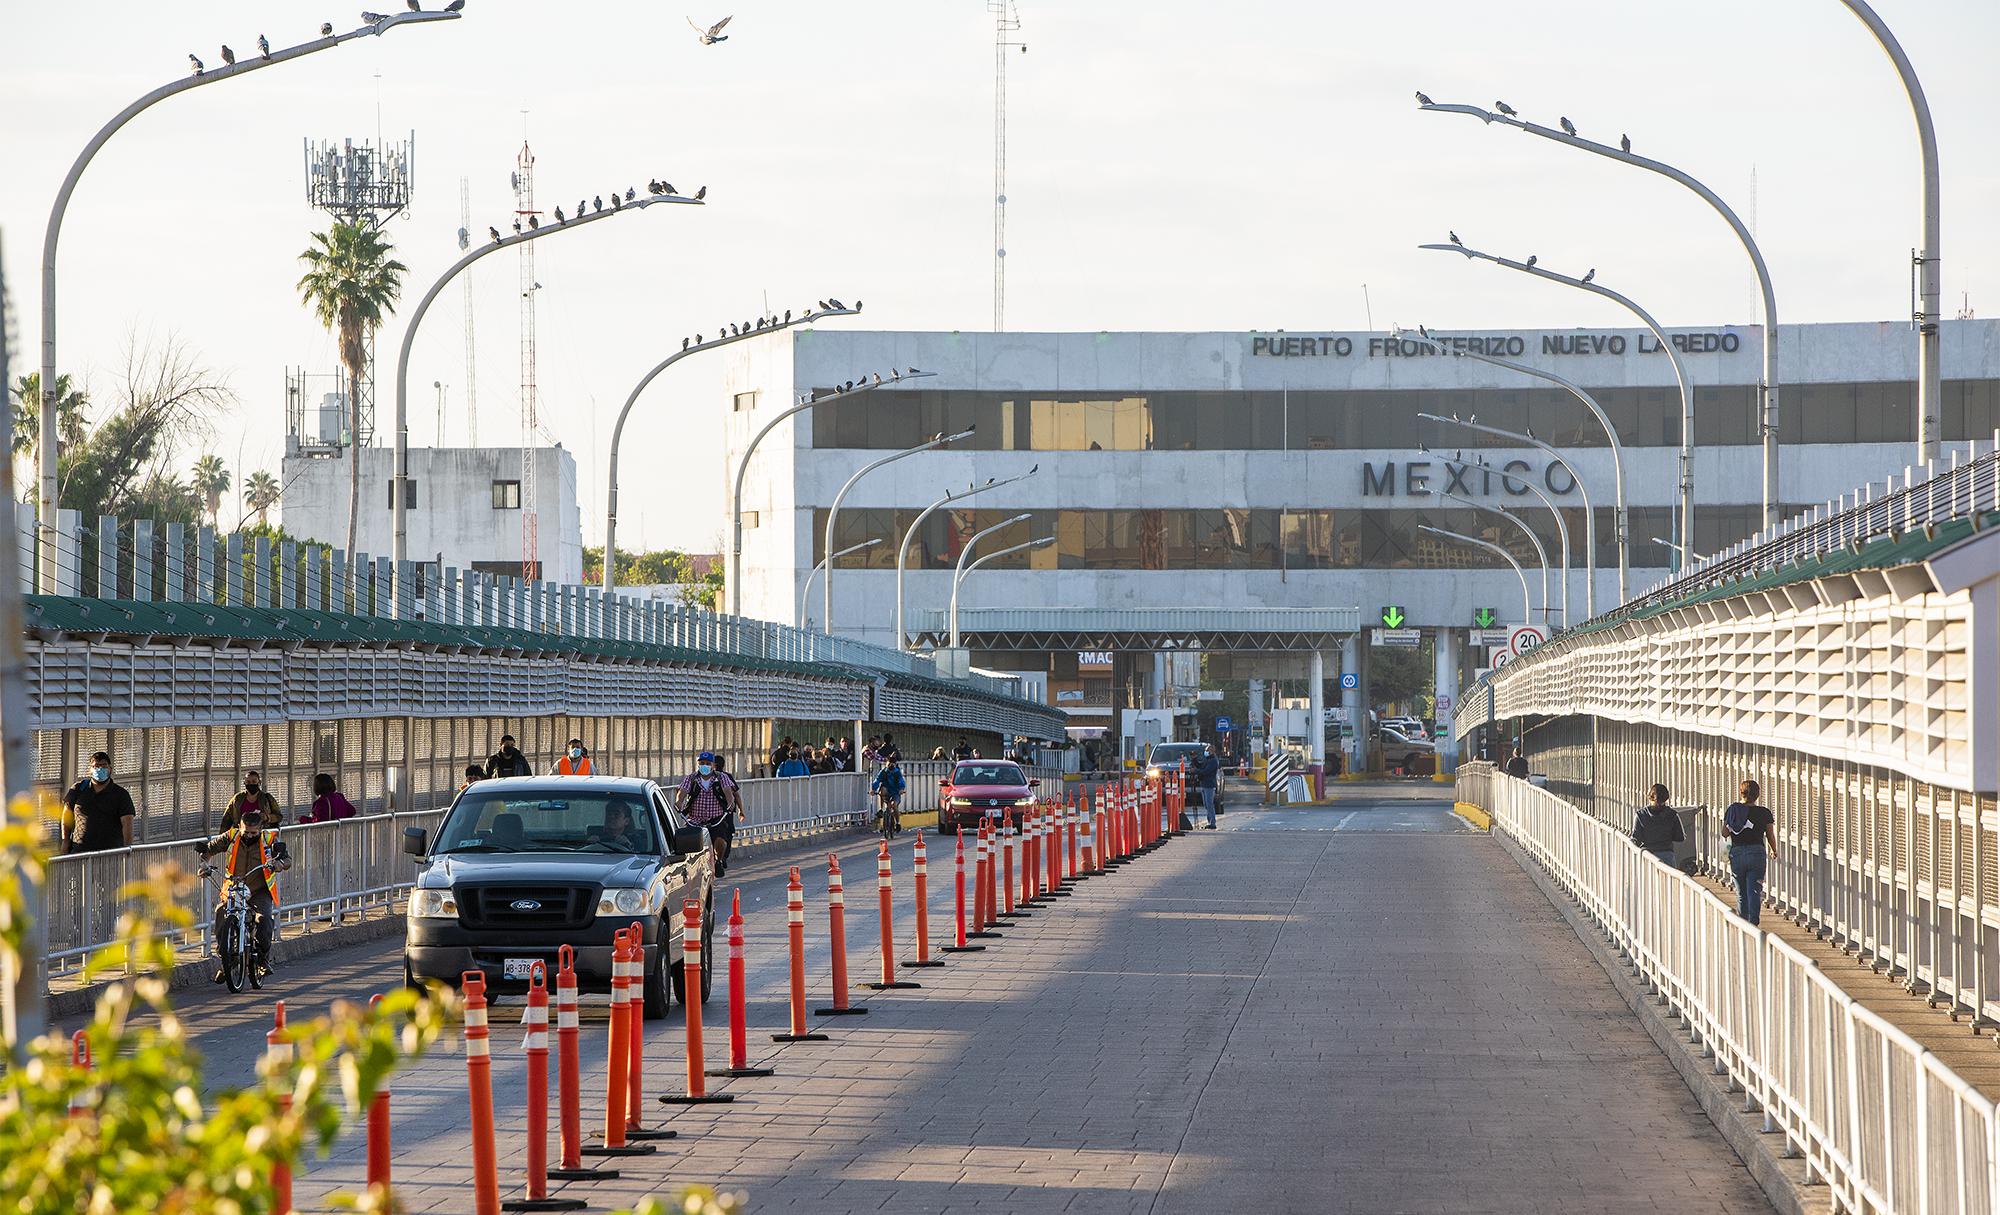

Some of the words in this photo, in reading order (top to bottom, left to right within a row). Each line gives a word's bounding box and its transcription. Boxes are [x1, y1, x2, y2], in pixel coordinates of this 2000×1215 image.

[1253, 337, 1353, 356] PUERTO
[1369, 336, 1525, 357] FRONTERIZO
[1542, 334, 1626, 355] NUEVO
[1638, 333, 1740, 354] LAREDO
[1363, 460, 1577, 496] MEXICO
[1520, 634, 1537, 648] 20
[1499, 655, 1507, 667] 2
[517, 900, 534, 909] Ford
